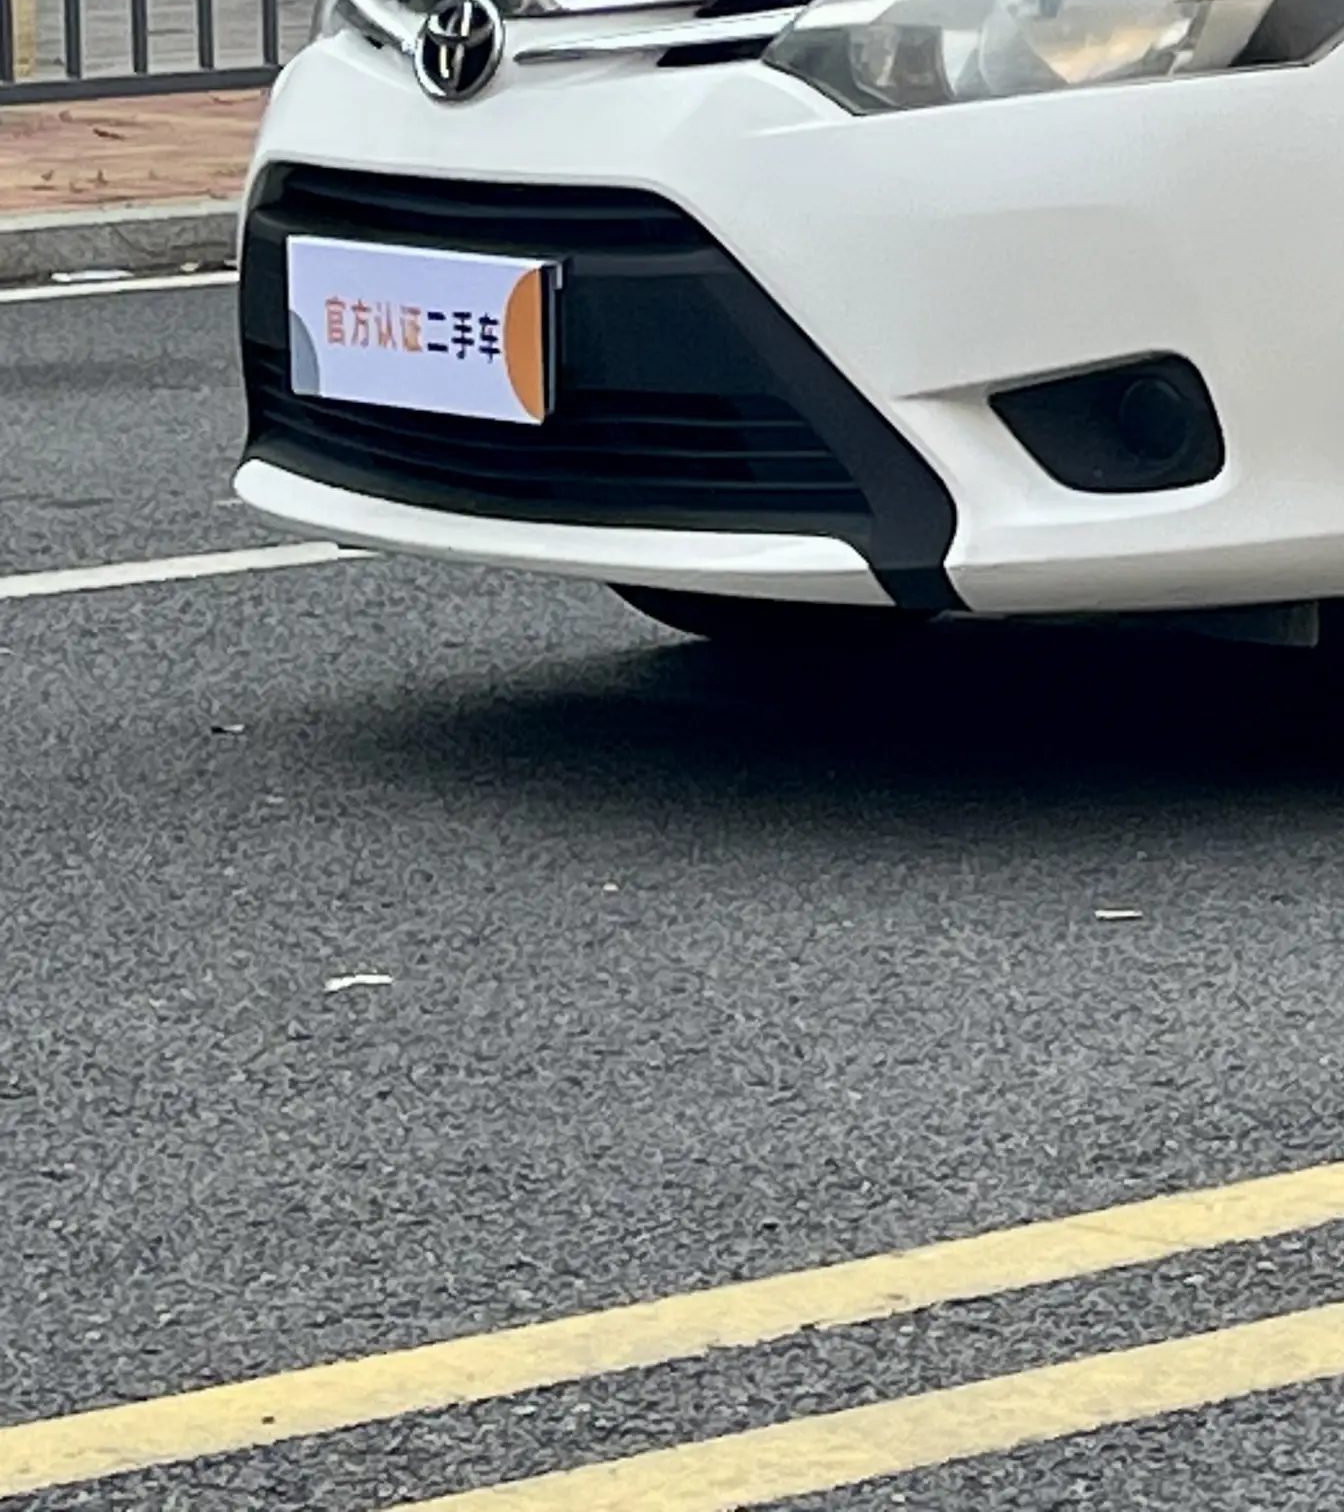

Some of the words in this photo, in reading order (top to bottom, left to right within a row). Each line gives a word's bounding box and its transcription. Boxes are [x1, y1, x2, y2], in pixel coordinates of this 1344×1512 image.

[325, 296, 501, 364] 官方认证二手车
